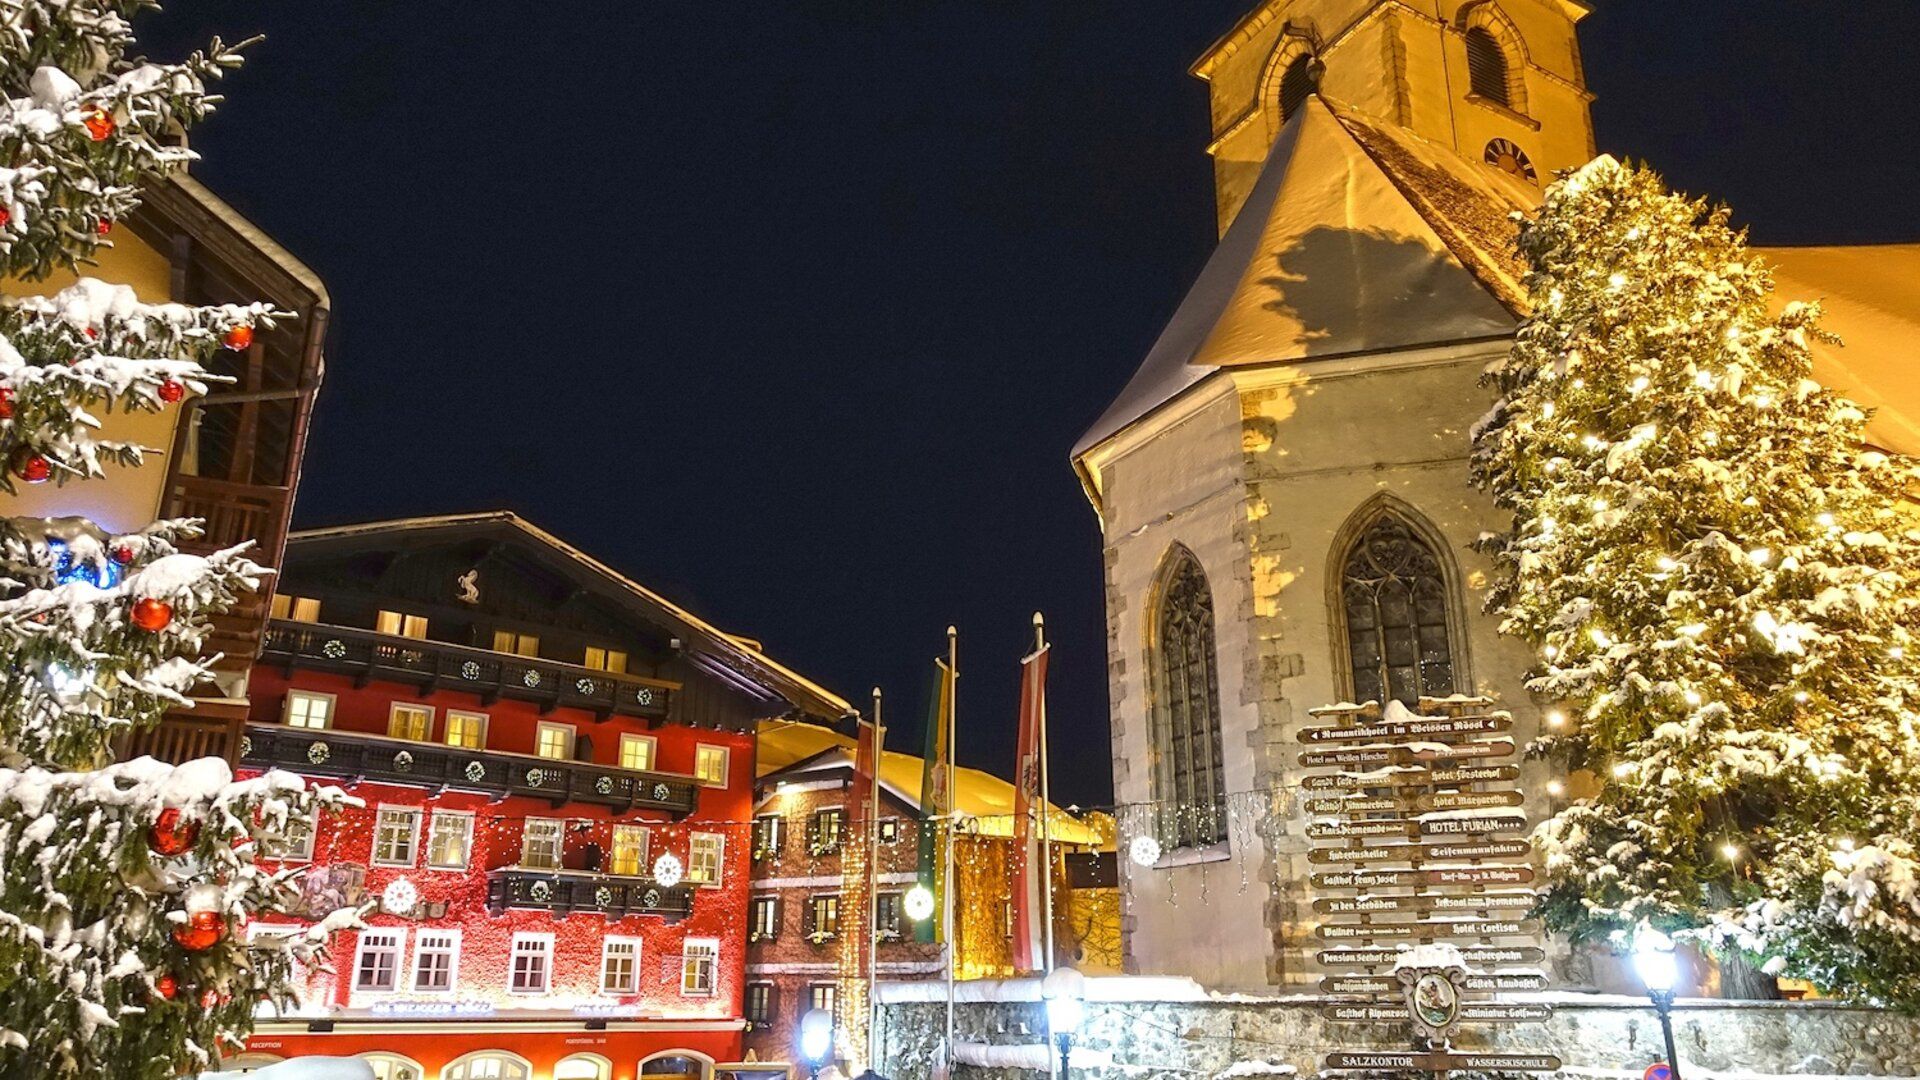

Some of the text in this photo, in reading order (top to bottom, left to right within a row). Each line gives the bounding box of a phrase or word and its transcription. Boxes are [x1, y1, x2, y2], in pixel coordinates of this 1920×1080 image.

[1321, 725, 1388, 739] Romantikhotel
[1393, 725, 1406, 734] im
[1410, 722, 1452, 733] Weissen
[1306, 755, 1324, 764] Hotel
[1360, 752, 1389, 761] Hirschen
[1431, 770, 1454, 782] Hotel
[1432, 797, 1455, 807] Hotel
[1429, 820, 1499, 833] HOTEL FURIAN
[1328, 849, 1389, 860] Hubertuskeller
[1430, 844, 1524, 857] Seifenmanufaktur
[1323, 873, 1398, 886] Gasthof Franz Josef
[1340, 901, 1355, 910] den
[1324, 927, 1355, 937] Wallner
[1453, 924, 1476, 934] Hotel
[1323, 953, 1356, 963] Pension
[1356, 952, 1383, 963] Seehof
[1462, 951, 1522, 961] chafbergbahn
[1336, 1008, 1367, 1018] Gasthof
[1342, 1056, 1414, 1067] SALZKONTOR
[1465, 1057, 1549, 1068] WASSERSKISCHULE
